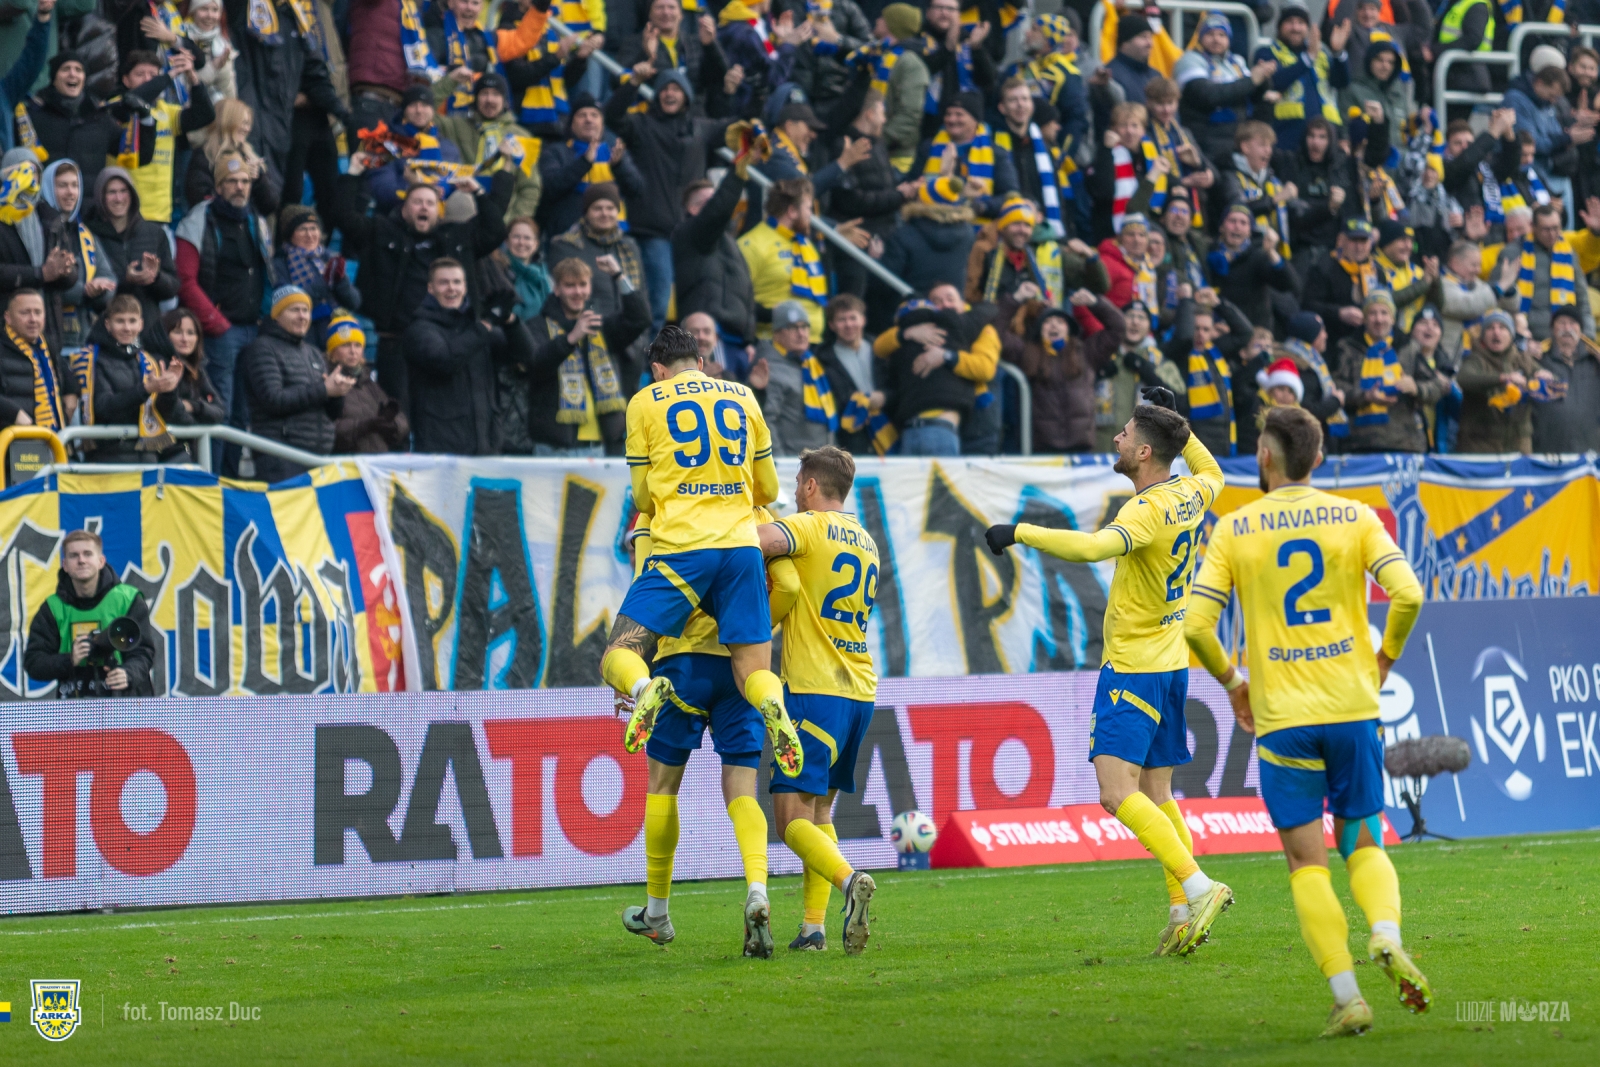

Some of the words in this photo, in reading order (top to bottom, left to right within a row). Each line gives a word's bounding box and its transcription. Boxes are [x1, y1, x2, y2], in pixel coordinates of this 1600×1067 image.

[651, 386, 670, 402] E.
[674, 381, 746, 397] ESPIAU
[666, 399, 747, 468] 99
[676, 482, 746, 496] SUPERBE
[1233, 517, 1255, 537] M.
[1260, 505, 1358, 531] NAVARRO
[820, 551, 879, 633] 29
[1277, 538, 1331, 627] 2
[1268, 636, 1354, 662] SUPERBE
[1549, 663, 1591, 703] PKO
[1556, 711, 1600, 778] EK
[313, 715, 647, 866] RATO
[989, 820, 1079, 846] STRAUSS
